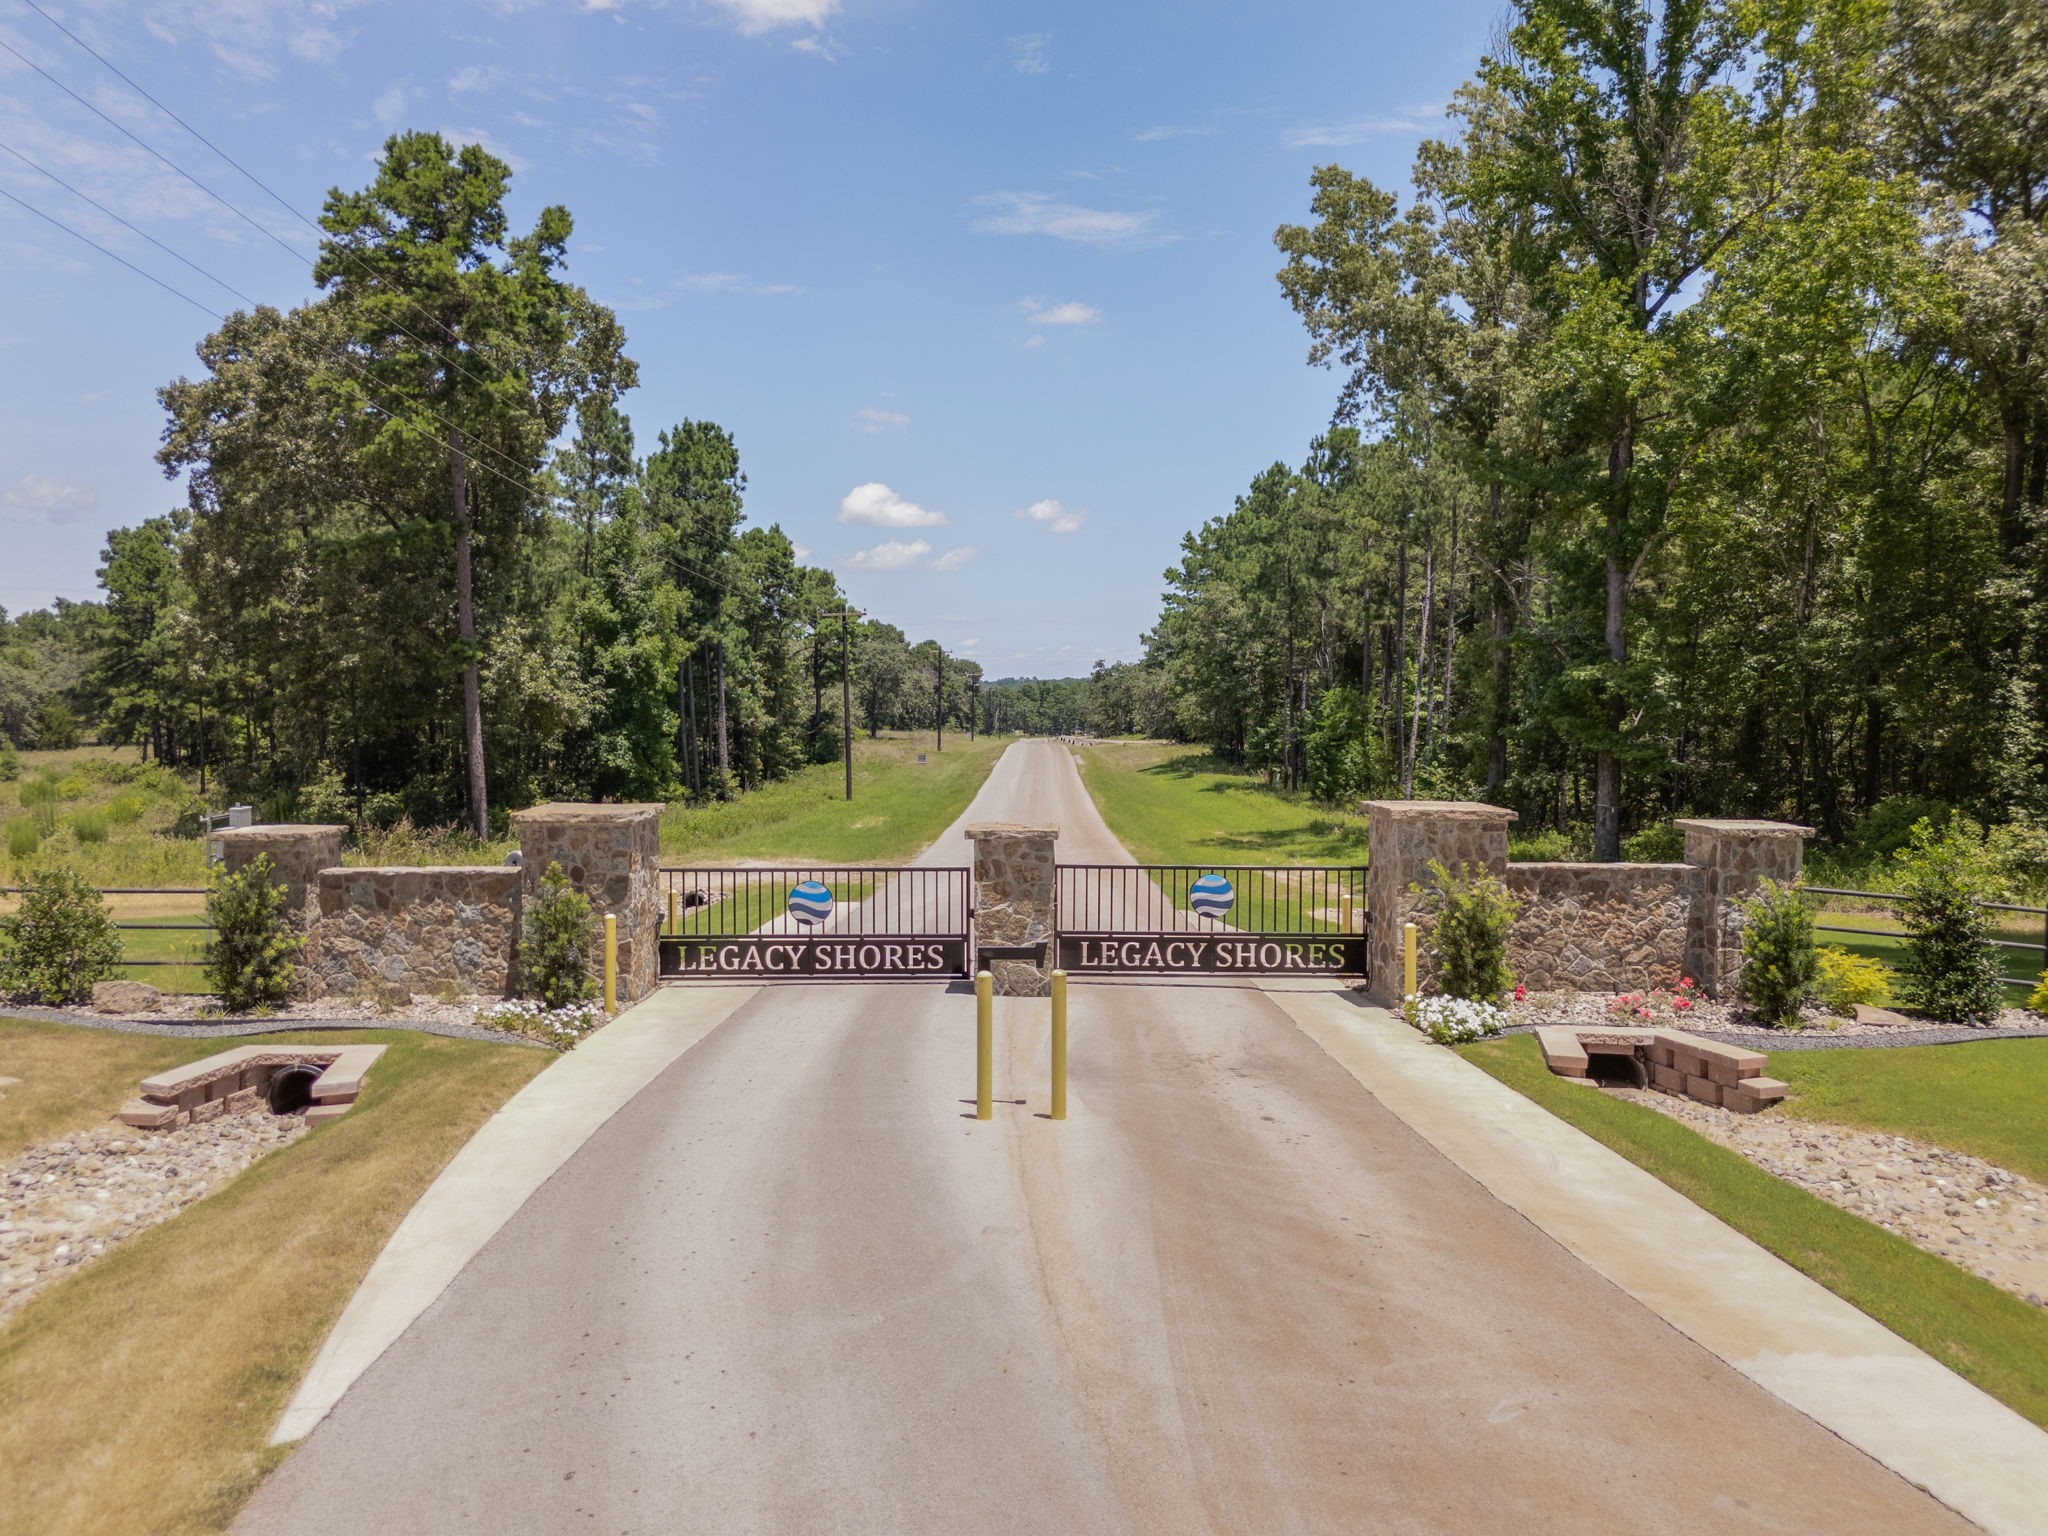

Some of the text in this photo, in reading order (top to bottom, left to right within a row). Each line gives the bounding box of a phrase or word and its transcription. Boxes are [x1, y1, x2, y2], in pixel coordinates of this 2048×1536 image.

[678, 944, 944, 970] LEGACY SHORES
[1080, 941, 1345, 968] LEGACY SHORES
